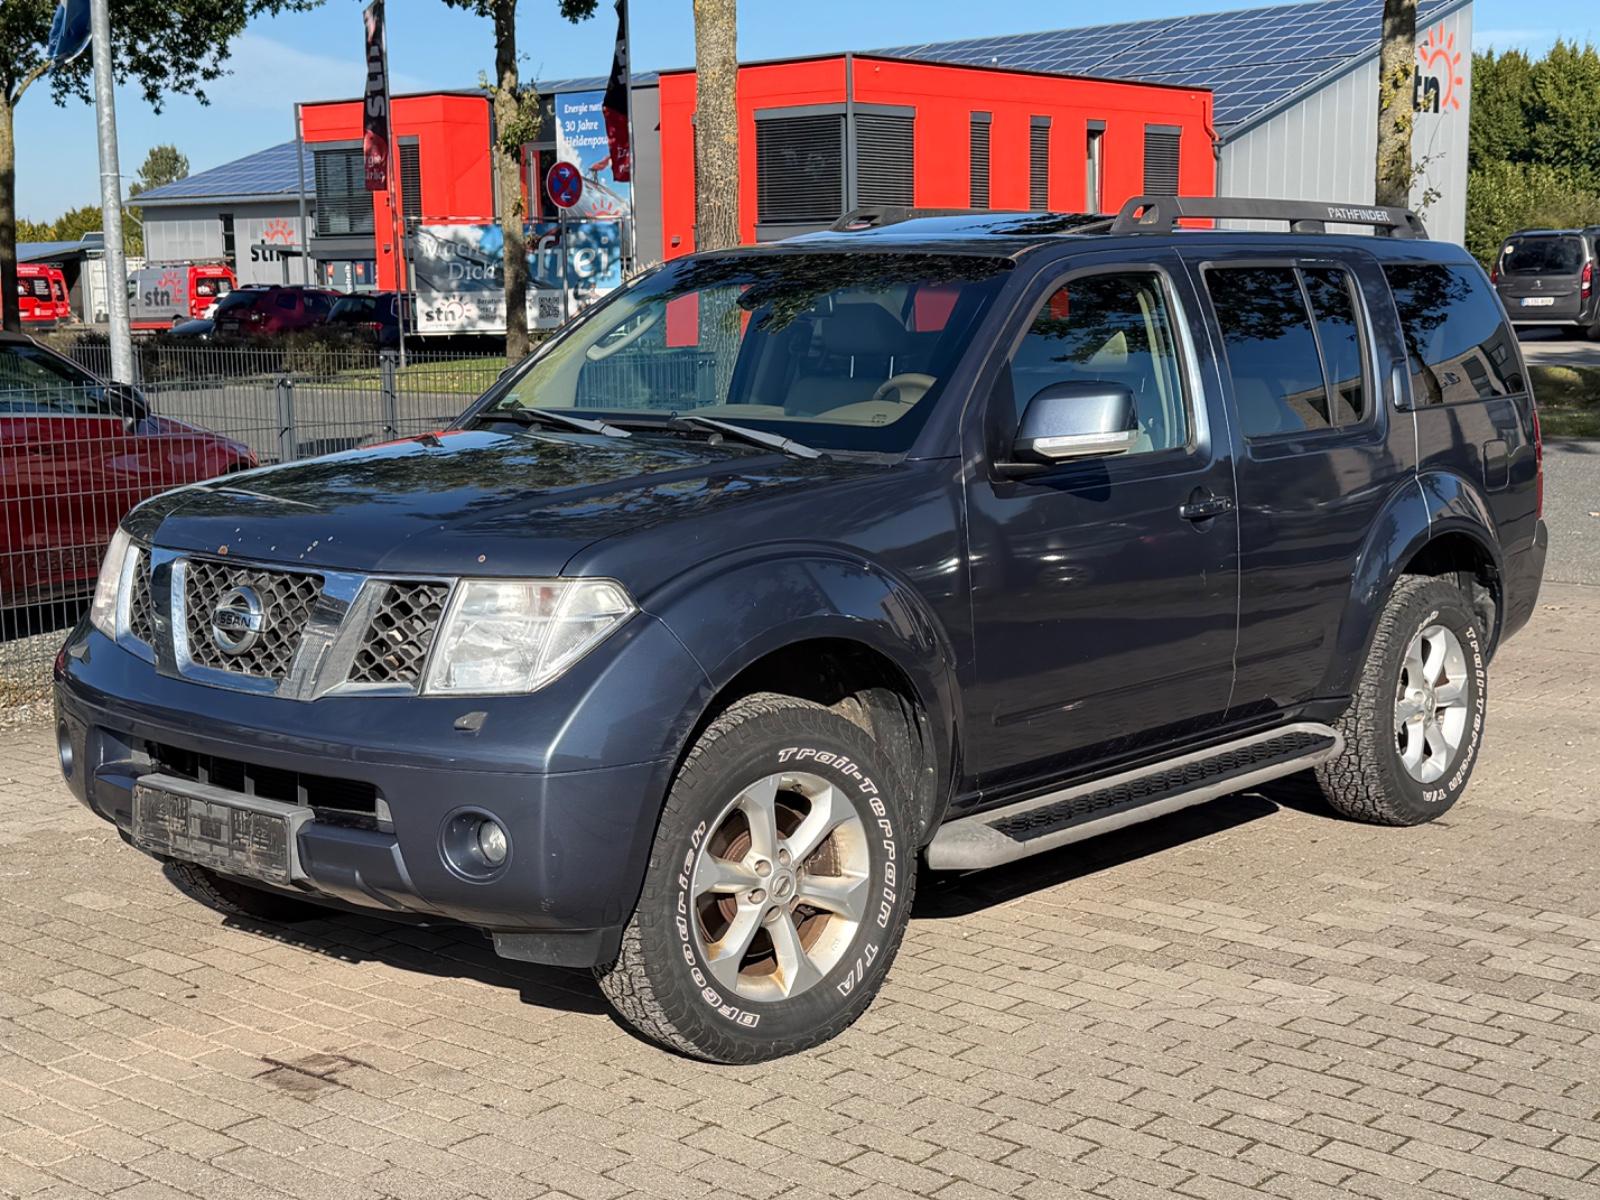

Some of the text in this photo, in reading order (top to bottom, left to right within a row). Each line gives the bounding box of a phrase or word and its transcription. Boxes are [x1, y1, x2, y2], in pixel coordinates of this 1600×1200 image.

[1412, 64, 1440, 114] tn
[563, 103, 588, 116] Energie
[564, 119, 599, 133] 30 Jahre
[1327, 207, 1390, 222] PATHFINDER
[144, 287, 171, 307] stn
[425, 307, 457, 323] stn
[675, 746, 896, 1028] BFGoodrich Trail-Terrain T/A
